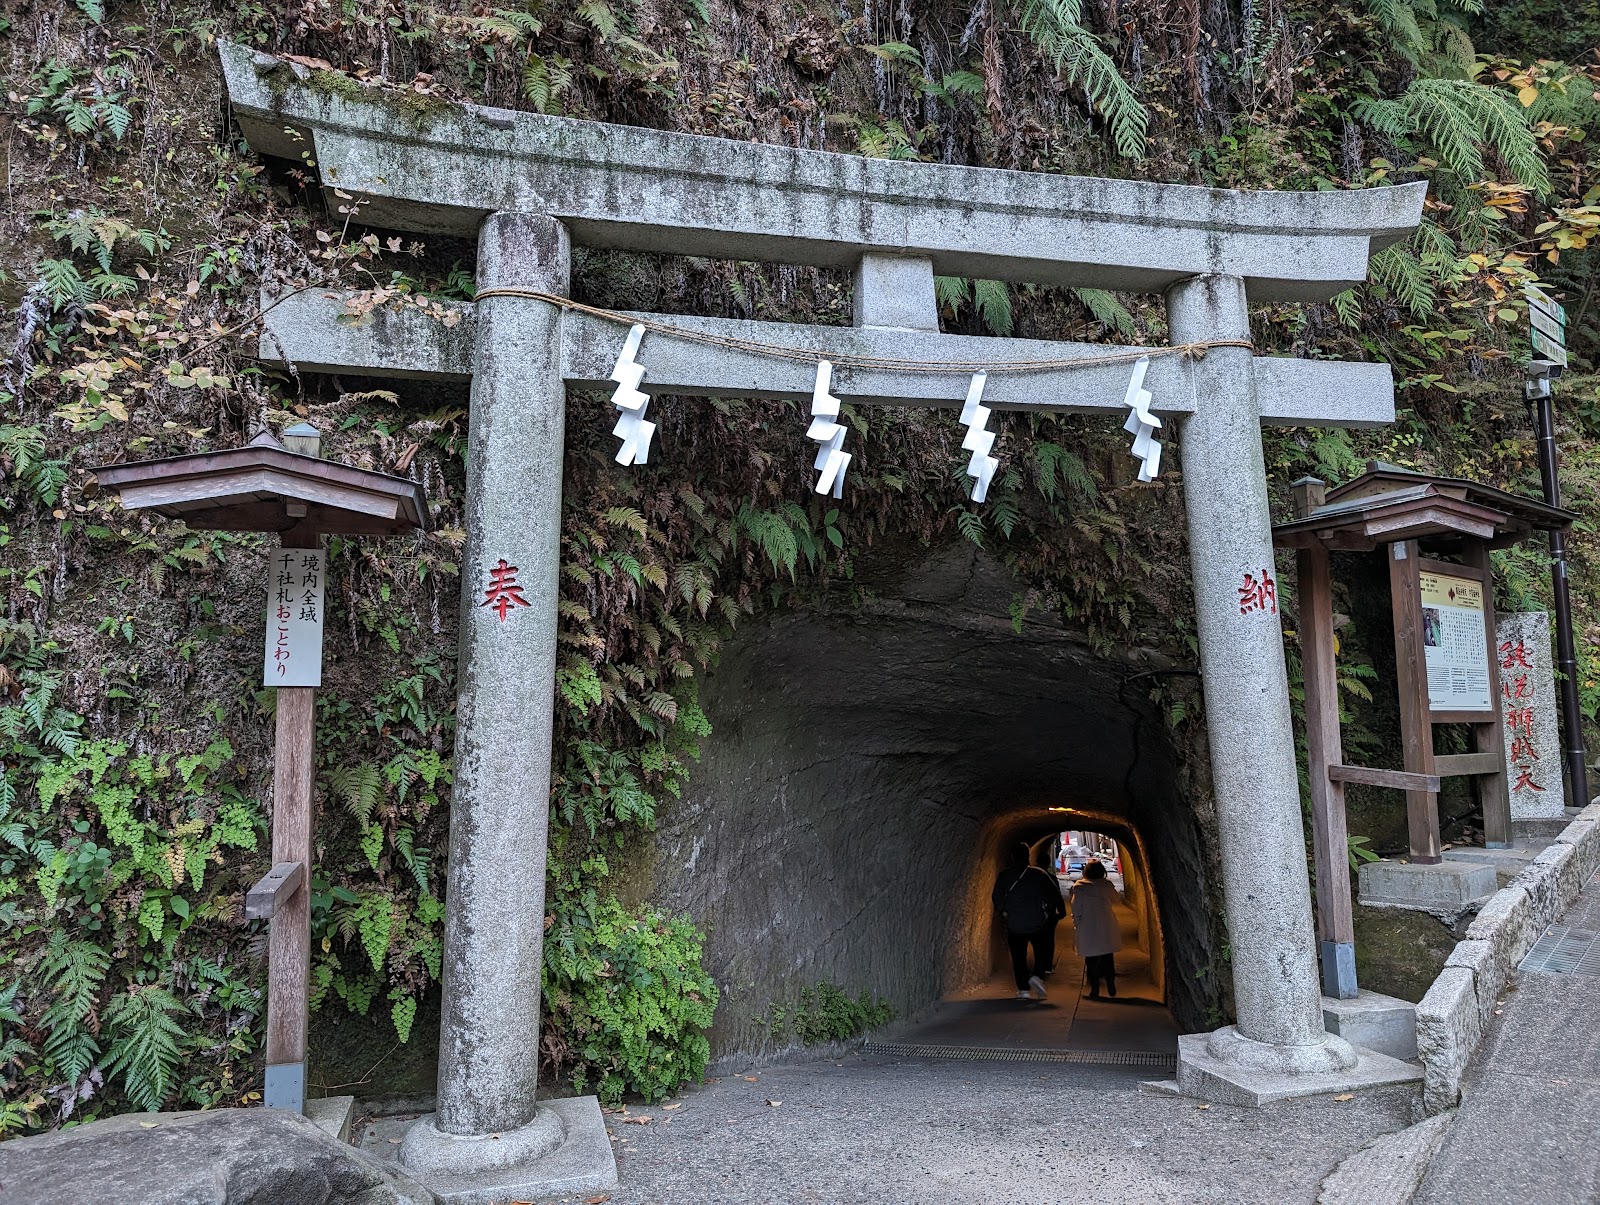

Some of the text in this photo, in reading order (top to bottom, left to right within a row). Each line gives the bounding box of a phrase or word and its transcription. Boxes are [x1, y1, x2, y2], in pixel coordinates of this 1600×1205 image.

[274, 553, 295, 678] 千社札おことわり
[298, 554, 320, 624] 境内全域
[478, 558, 532, 623] 奉
[1238, 568, 1276, 615] 納
